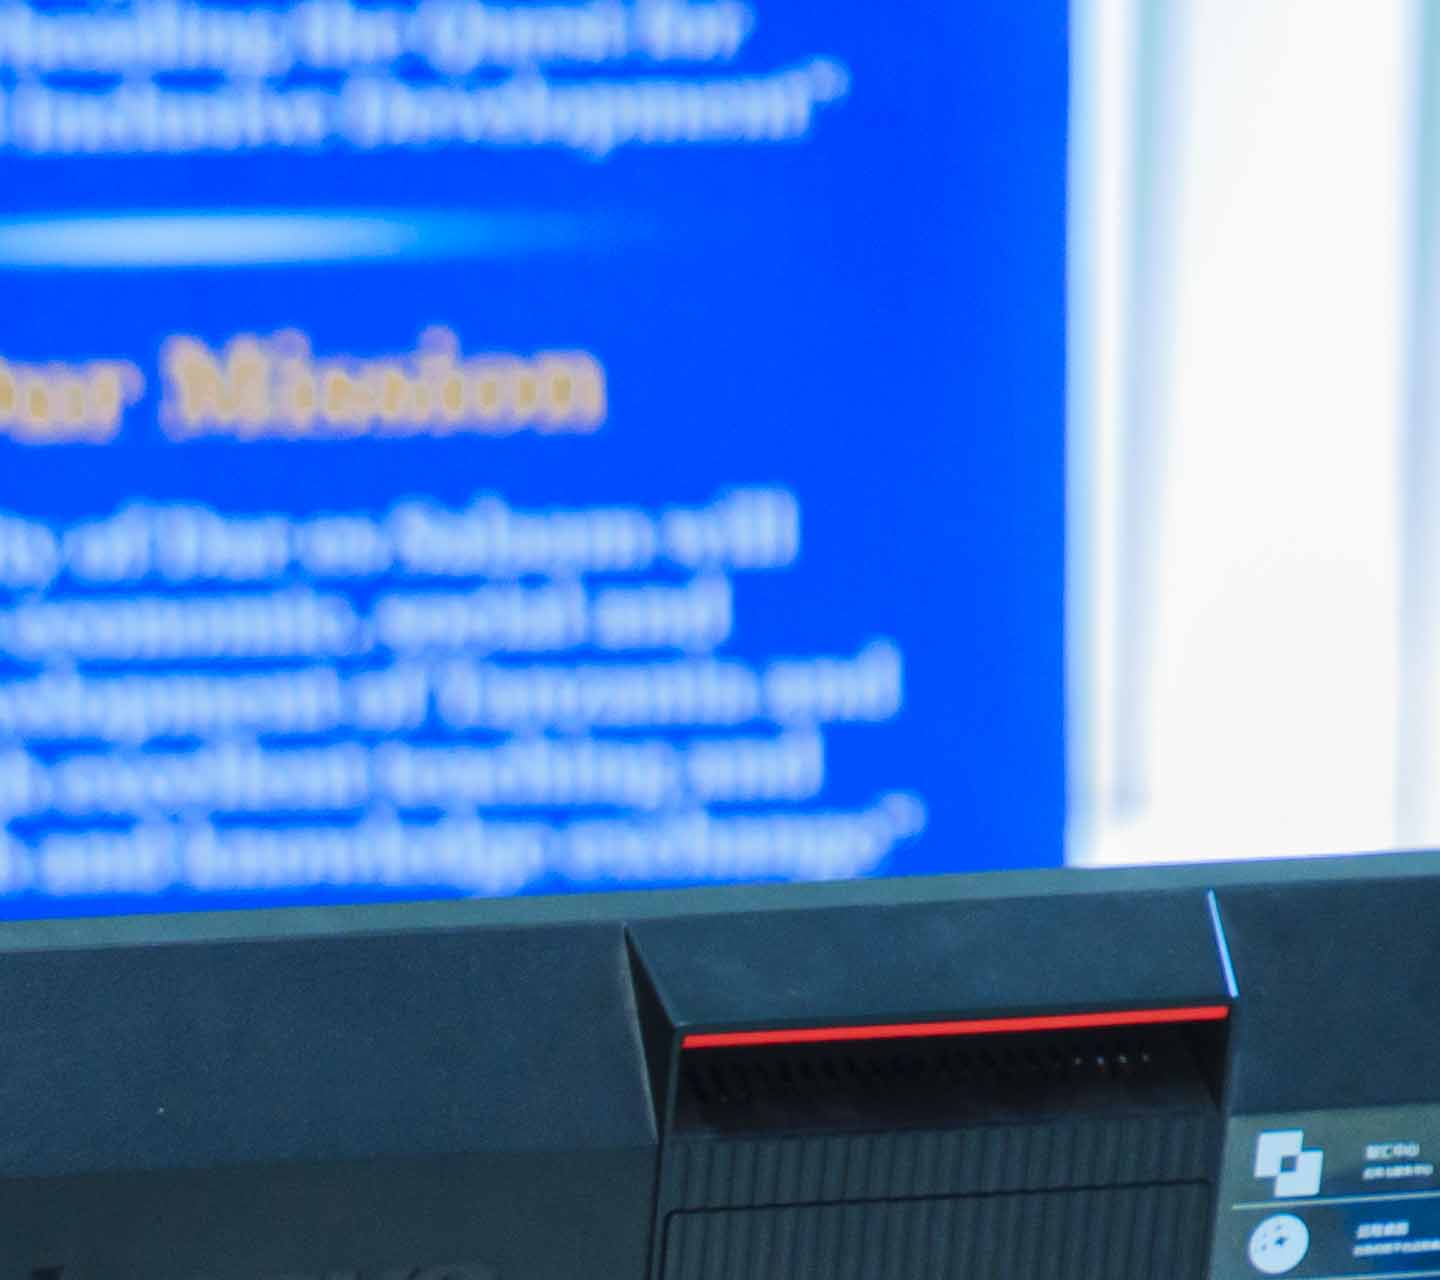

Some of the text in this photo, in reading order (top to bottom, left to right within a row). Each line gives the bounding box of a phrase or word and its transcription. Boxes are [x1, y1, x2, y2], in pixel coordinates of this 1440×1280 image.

[158, 327, 607, 440] Mission
[62, 500, 156, 582] of
[158, 500, 288, 582] Dar
[388, 495, 655, 576] Salaam
[660, 488, 800, 570] will
[370, 580, 588, 654] social
[592, 570, 734, 648] and
[346, 652, 432, 732] of
[434, 652, 760, 732] Tanzania
[764, 638, 903, 722] and
[44, 734, 370, 818] excellent
[372, 726, 680, 816] teaching
[686, 722, 823, 802] and
[38, 816, 178, 896] and
[180, 802, 546, 898] knowledge
